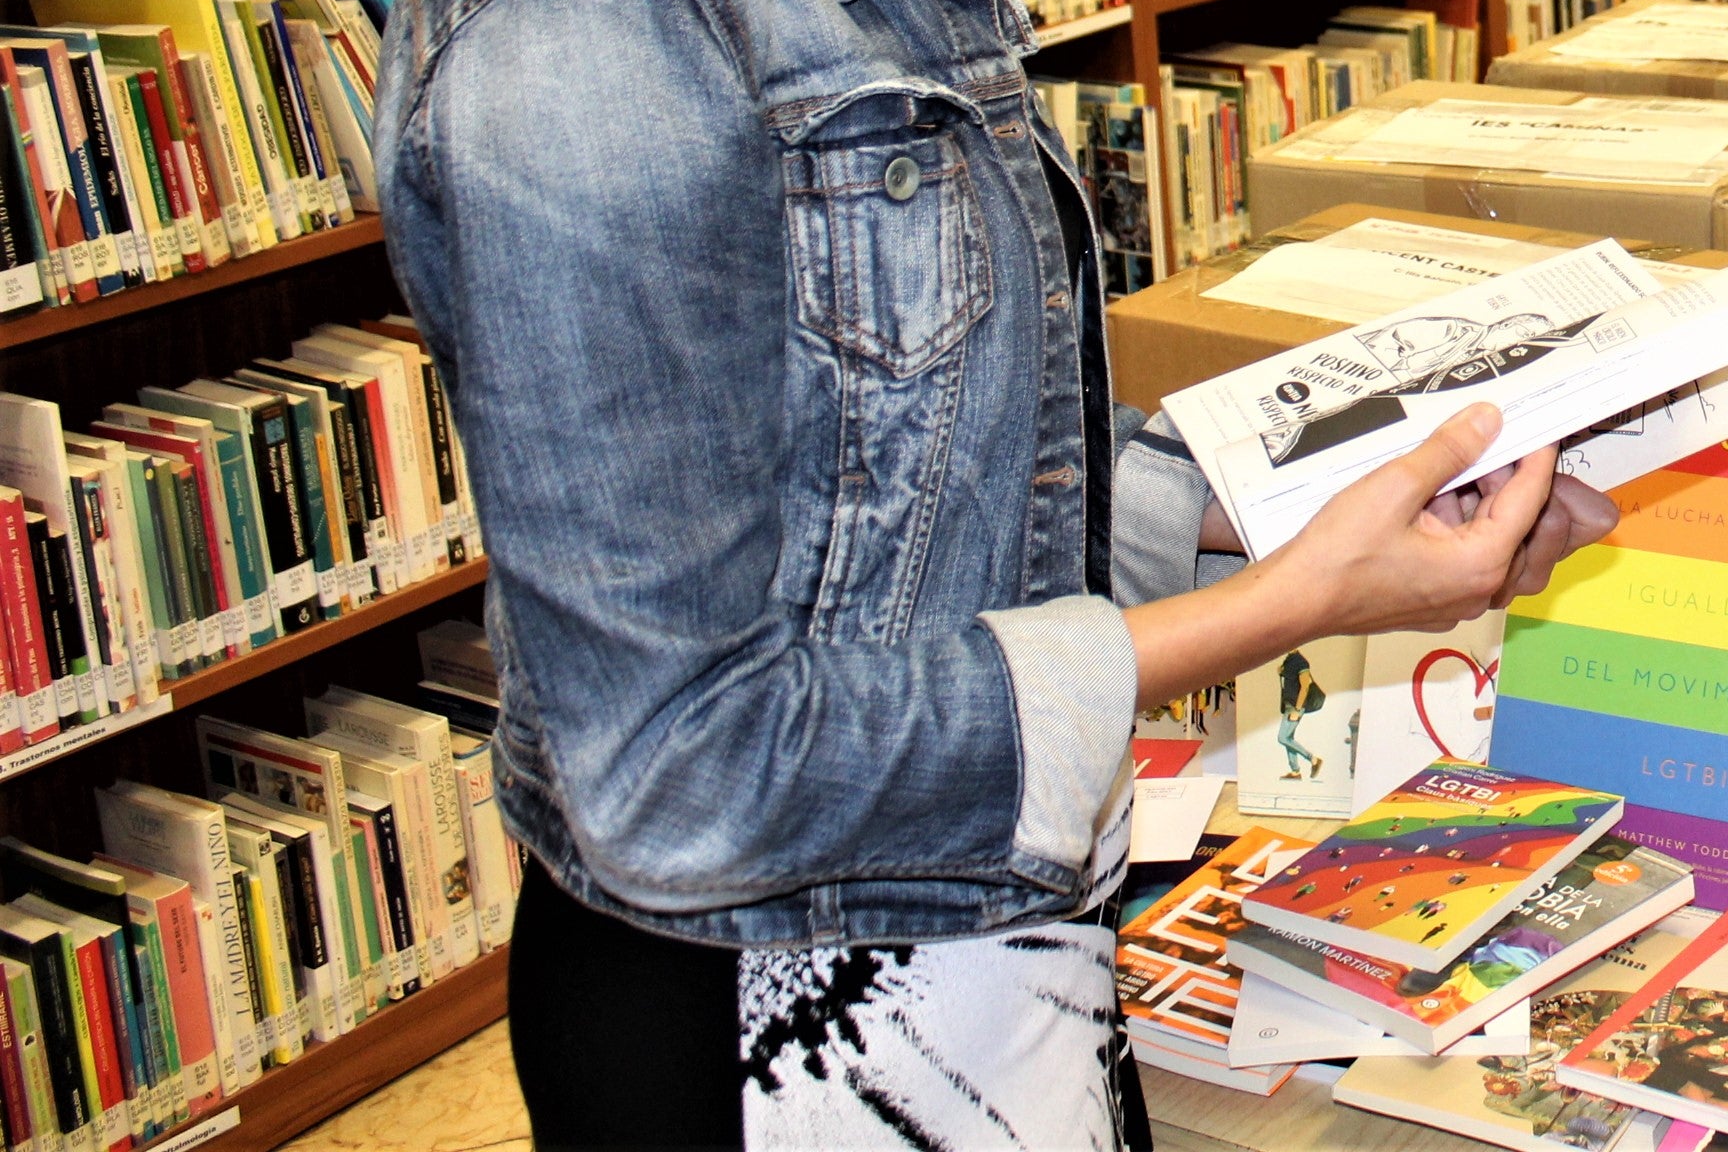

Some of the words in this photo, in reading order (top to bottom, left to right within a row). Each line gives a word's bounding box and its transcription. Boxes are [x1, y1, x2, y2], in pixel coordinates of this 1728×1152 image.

[254, 102, 278, 161] OBESIDAD
[106, 169, 120, 196] Sacks
[1309, 352, 1383, 381] POSITIVO
[1619, 501, 1642, 515] LA
[1655, 505, 1725, 528] LUCHA
[76, 555, 88, 586] psicosis
[83, 594, 97, 641] Comprender
[1563, 656, 1614, 682] DEL
[10, 744, 61, 769] Trastornos
[63, 727, 106, 747] mentales
[436, 732, 458, 792] PADRES
[1642, 755, 1728, 789] LGTBI
[427, 758, 451, 835] LAROUSSE
[1416, 785, 1446, 798] Claus
[1425, 775, 1502, 802] LGTBI
[203, 820, 231, 872] NIÑO
[1618, 829, 1687, 851] MATTHEW
[211, 871, 236, 899] EL
[1559, 885, 1584, 899] DE
[1583, 893, 1604, 908] LA
[216, 898, 237, 918] Y
[1535, 912, 1571, 931] ella
[217, 917, 249, 986] MADRE
[1319, 945, 1393, 980] MARTÍNEZ
[278, 960, 292, 993] natural
[232, 989, 252, 1016] LA
